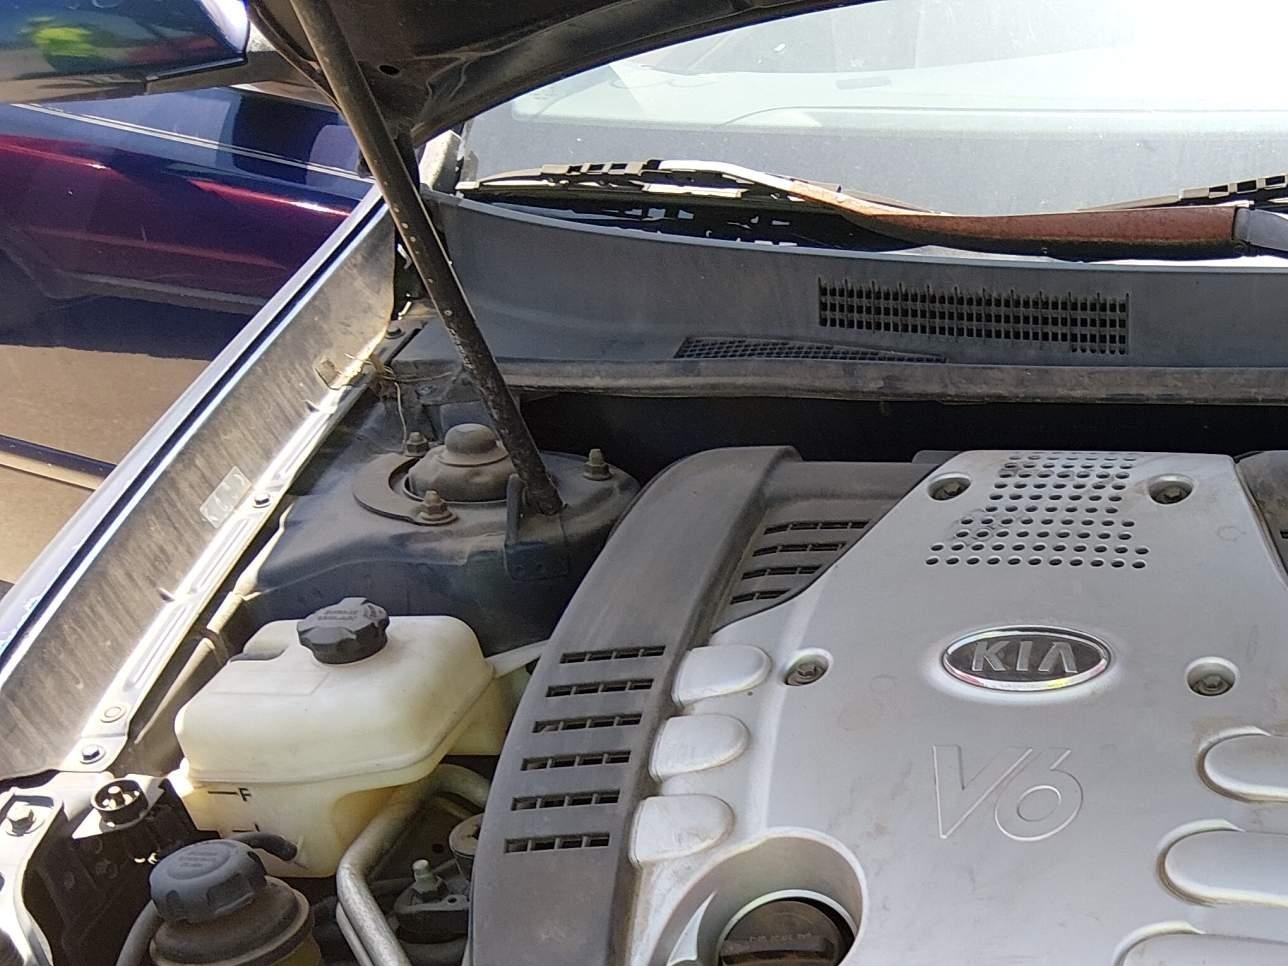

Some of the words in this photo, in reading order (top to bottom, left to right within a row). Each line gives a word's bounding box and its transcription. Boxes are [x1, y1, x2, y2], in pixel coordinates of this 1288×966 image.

[972, 640, 1078, 673] KIA
[238, 787, 251, 802] F
[931, 744, 1084, 841] V6
